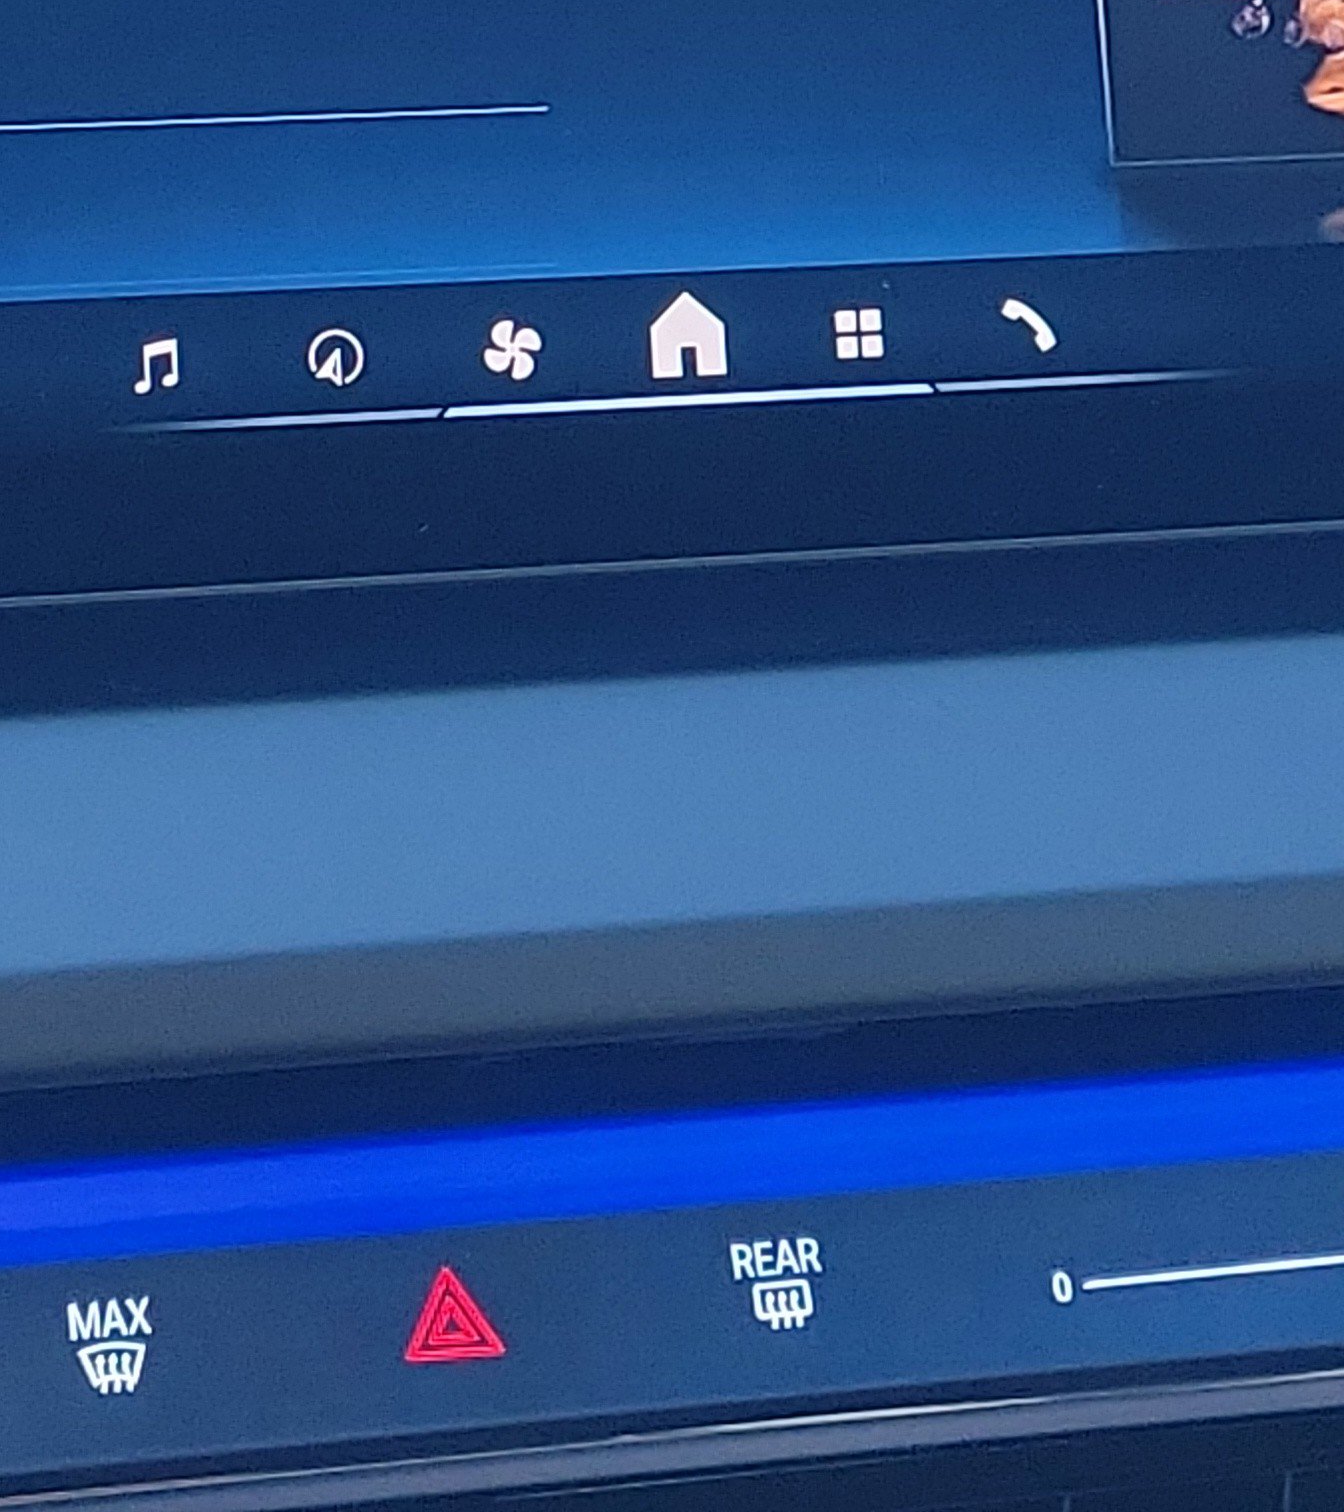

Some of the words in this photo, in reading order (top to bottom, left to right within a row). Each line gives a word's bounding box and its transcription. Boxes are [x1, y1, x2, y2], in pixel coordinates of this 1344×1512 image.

[730, 1237, 822, 1280] REAR
[1052, 1271, 1074, 1304] 0
[67, 1296, 153, 1342] MAX
